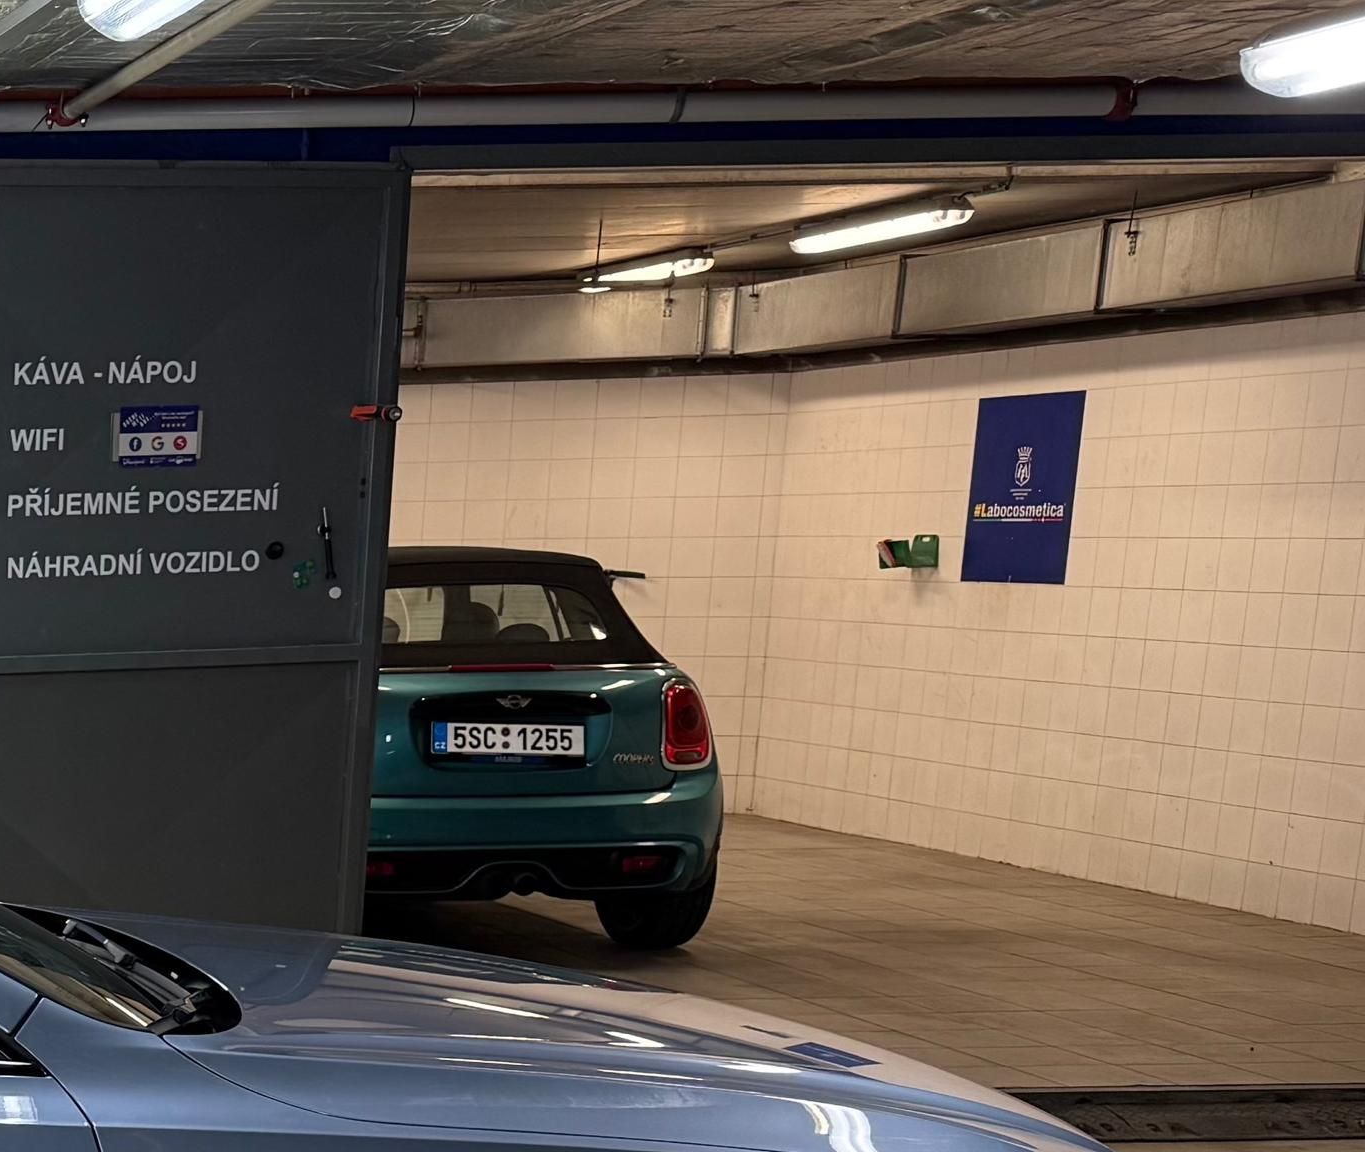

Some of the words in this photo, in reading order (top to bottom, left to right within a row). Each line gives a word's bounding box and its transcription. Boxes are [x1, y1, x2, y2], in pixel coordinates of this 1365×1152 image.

[14, 356, 84, 386] KÁVA
[108, 355, 197, 384] NÁPOJ
[10, 428, 65, 451] WIFI
[7, 485, 140, 517] PŘÍJEMNÉ
[149, 482, 280, 513] POSEZENÍ
[973, 502, 1064, 518] #Labocosmetica
[7, 549, 142, 579] NÁHRADNÍ
[149, 550, 260, 574] VOZIDLO
[453, 726, 496, 749] 5SC
[517, 728, 573, 751] 1255
